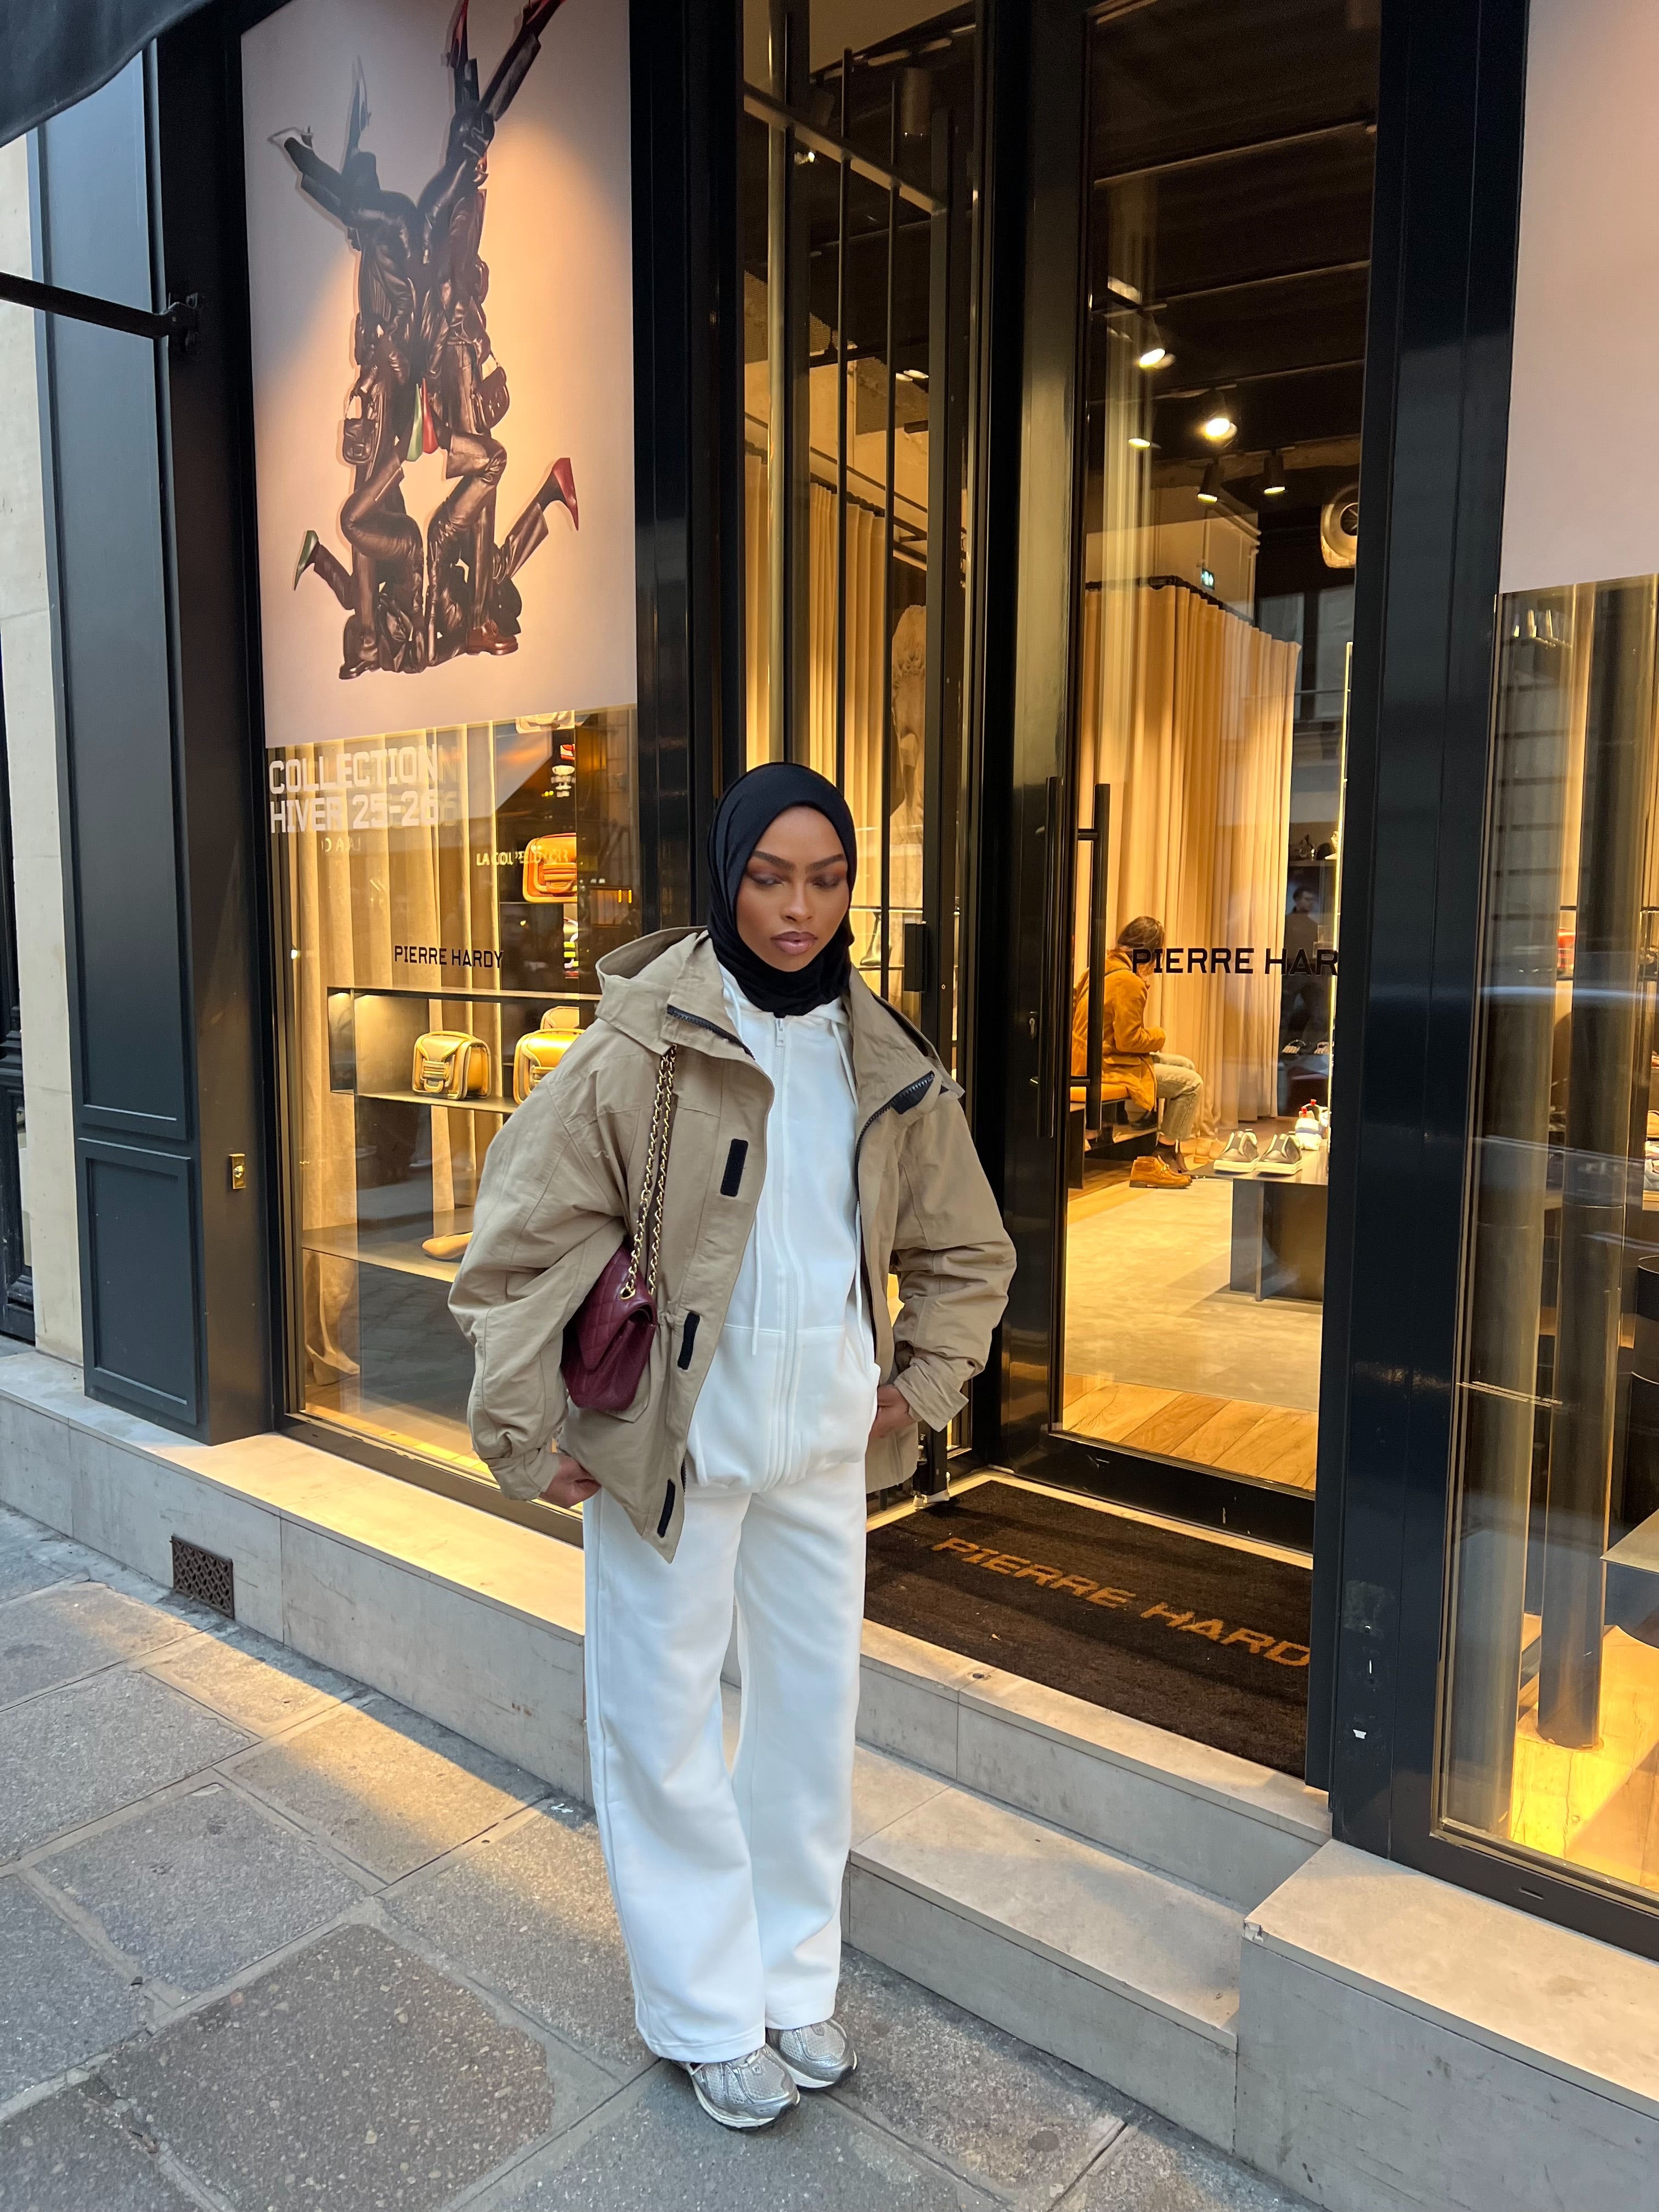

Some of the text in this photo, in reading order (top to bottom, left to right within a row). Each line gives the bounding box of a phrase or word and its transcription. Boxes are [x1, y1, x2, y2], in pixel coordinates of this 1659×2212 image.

[268, 743, 439, 794] COLLECTION
[270, 788, 439, 833] HIVER 25-26
[394, 945, 504, 968] PIERRE HARDY
[1132, 947, 1255, 974] PIERRE
[931, 1537, 1311, 1667] PIERRE HARD
